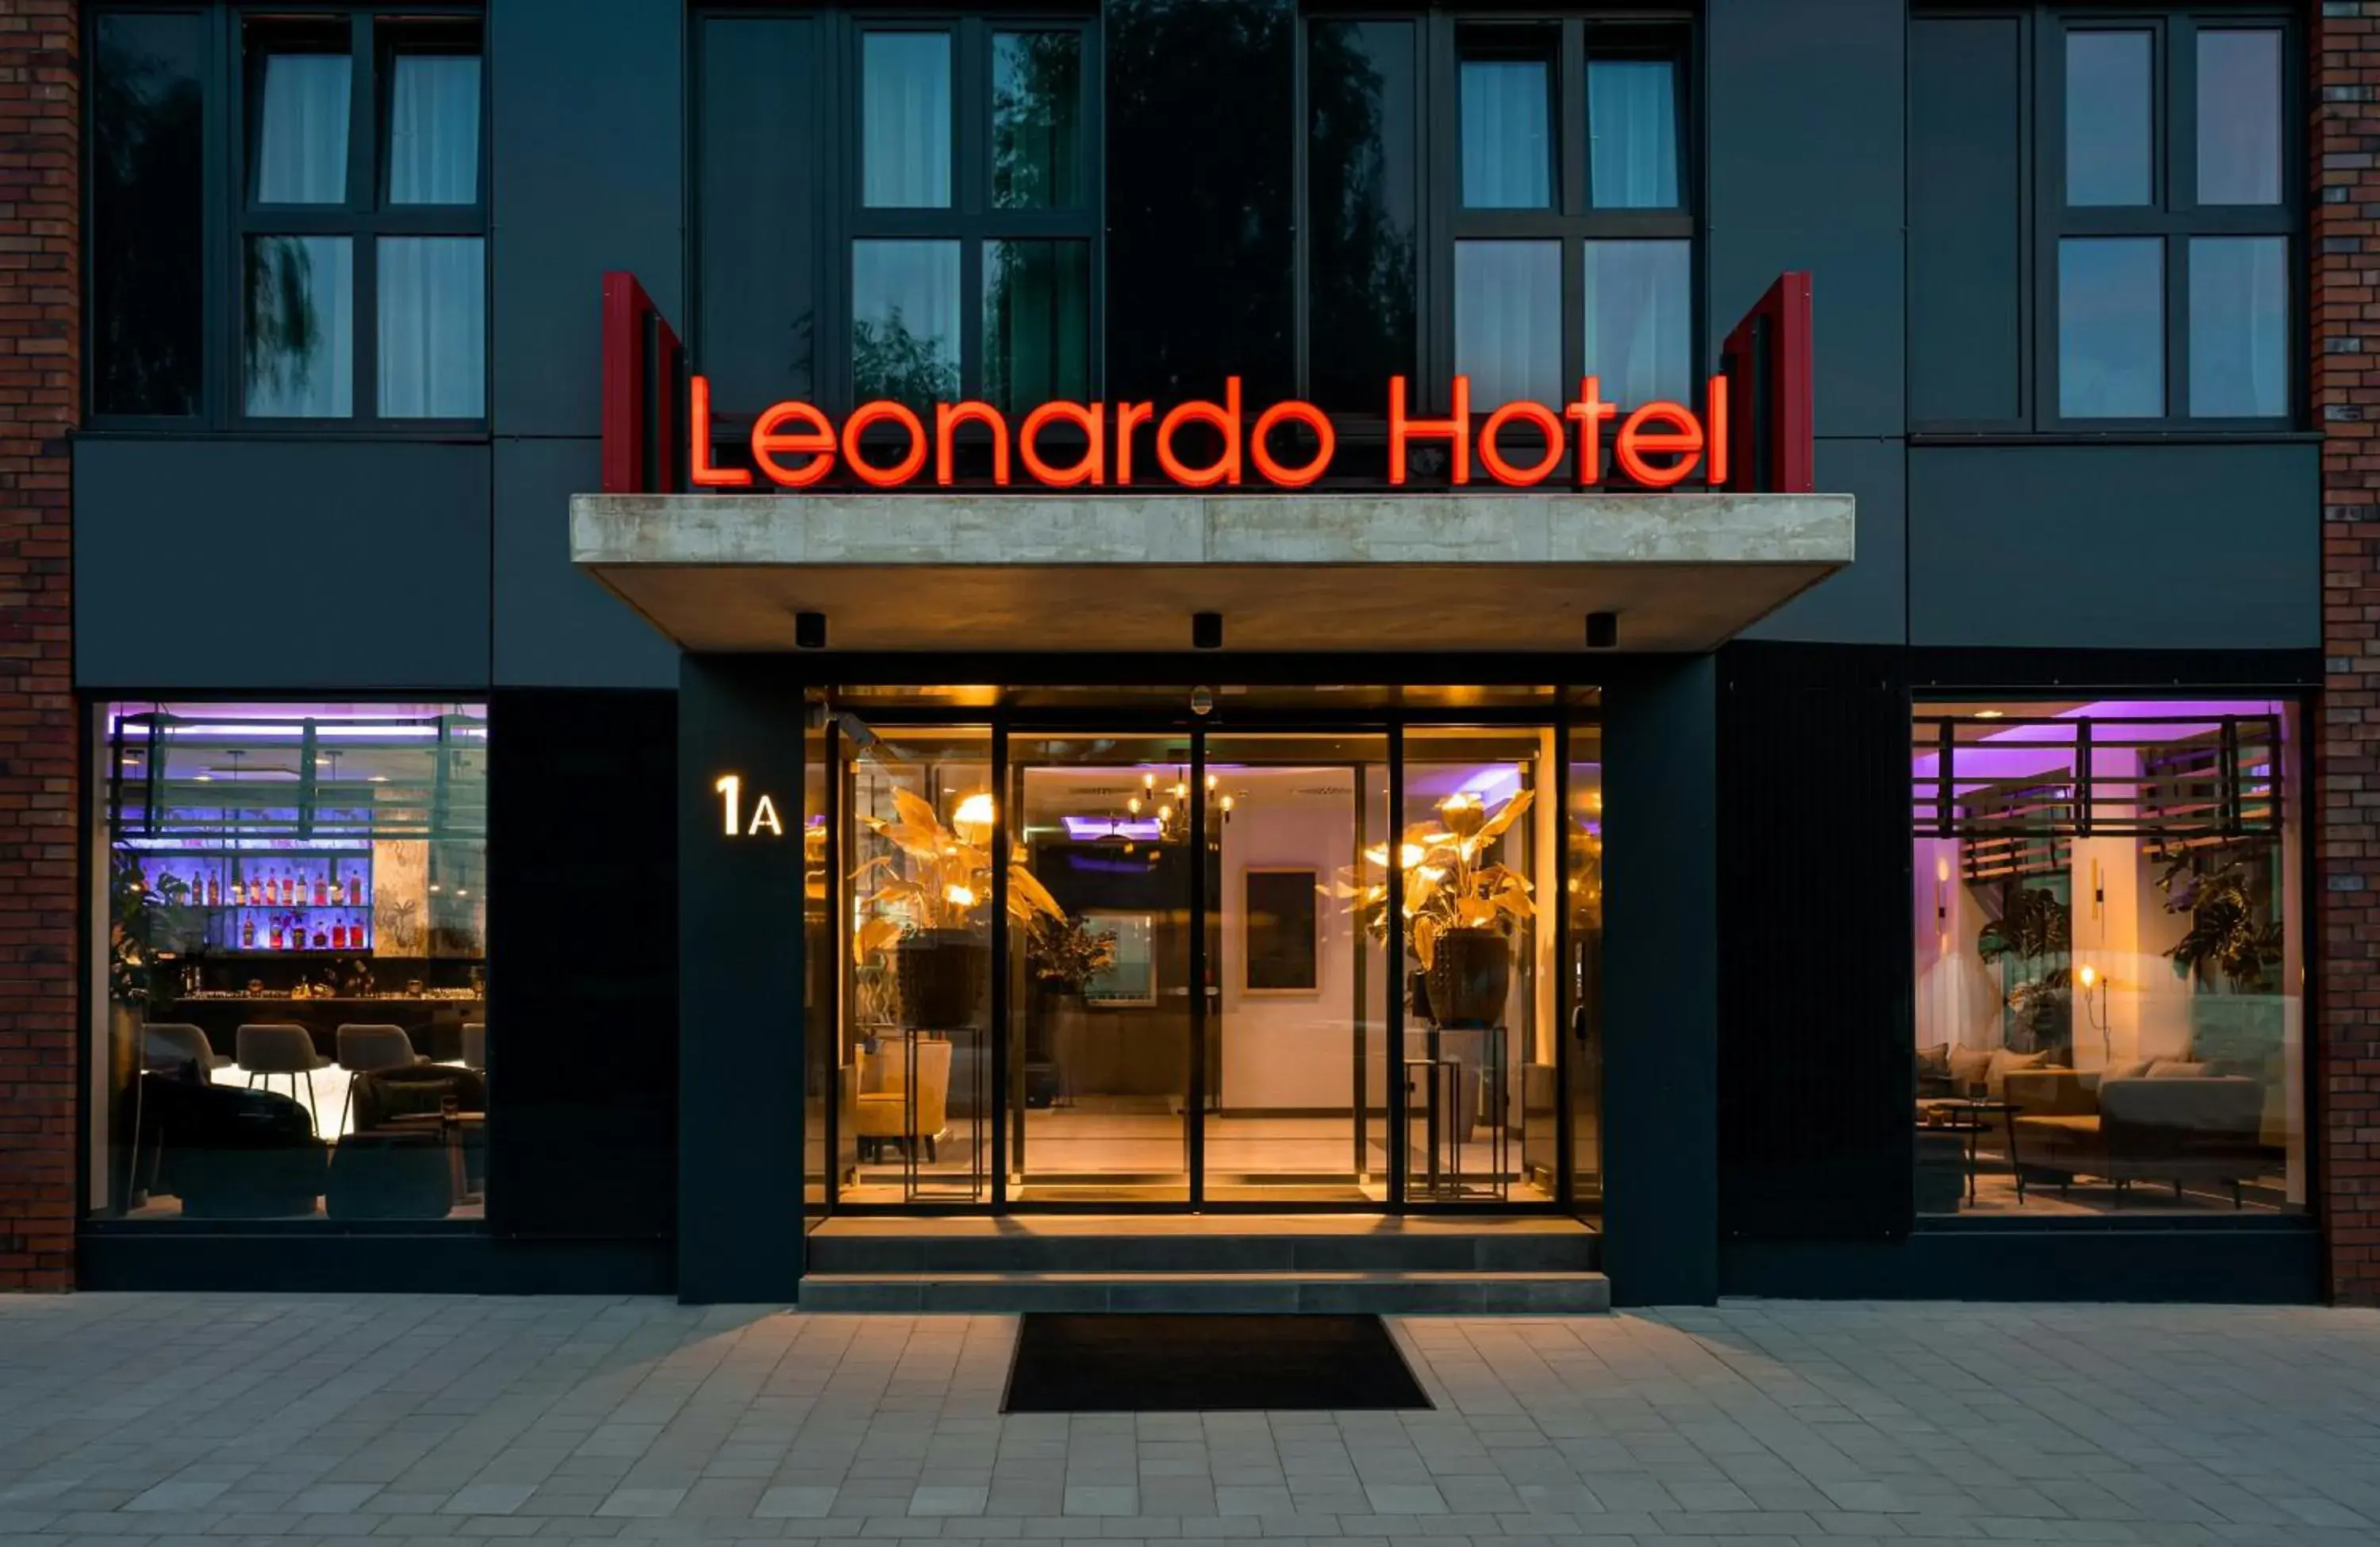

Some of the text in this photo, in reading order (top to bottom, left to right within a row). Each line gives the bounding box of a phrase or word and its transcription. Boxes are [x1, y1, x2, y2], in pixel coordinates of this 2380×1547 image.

[691, 375, 1727, 486] Leonardo Hotel
[716, 775, 782, 835] 1A
